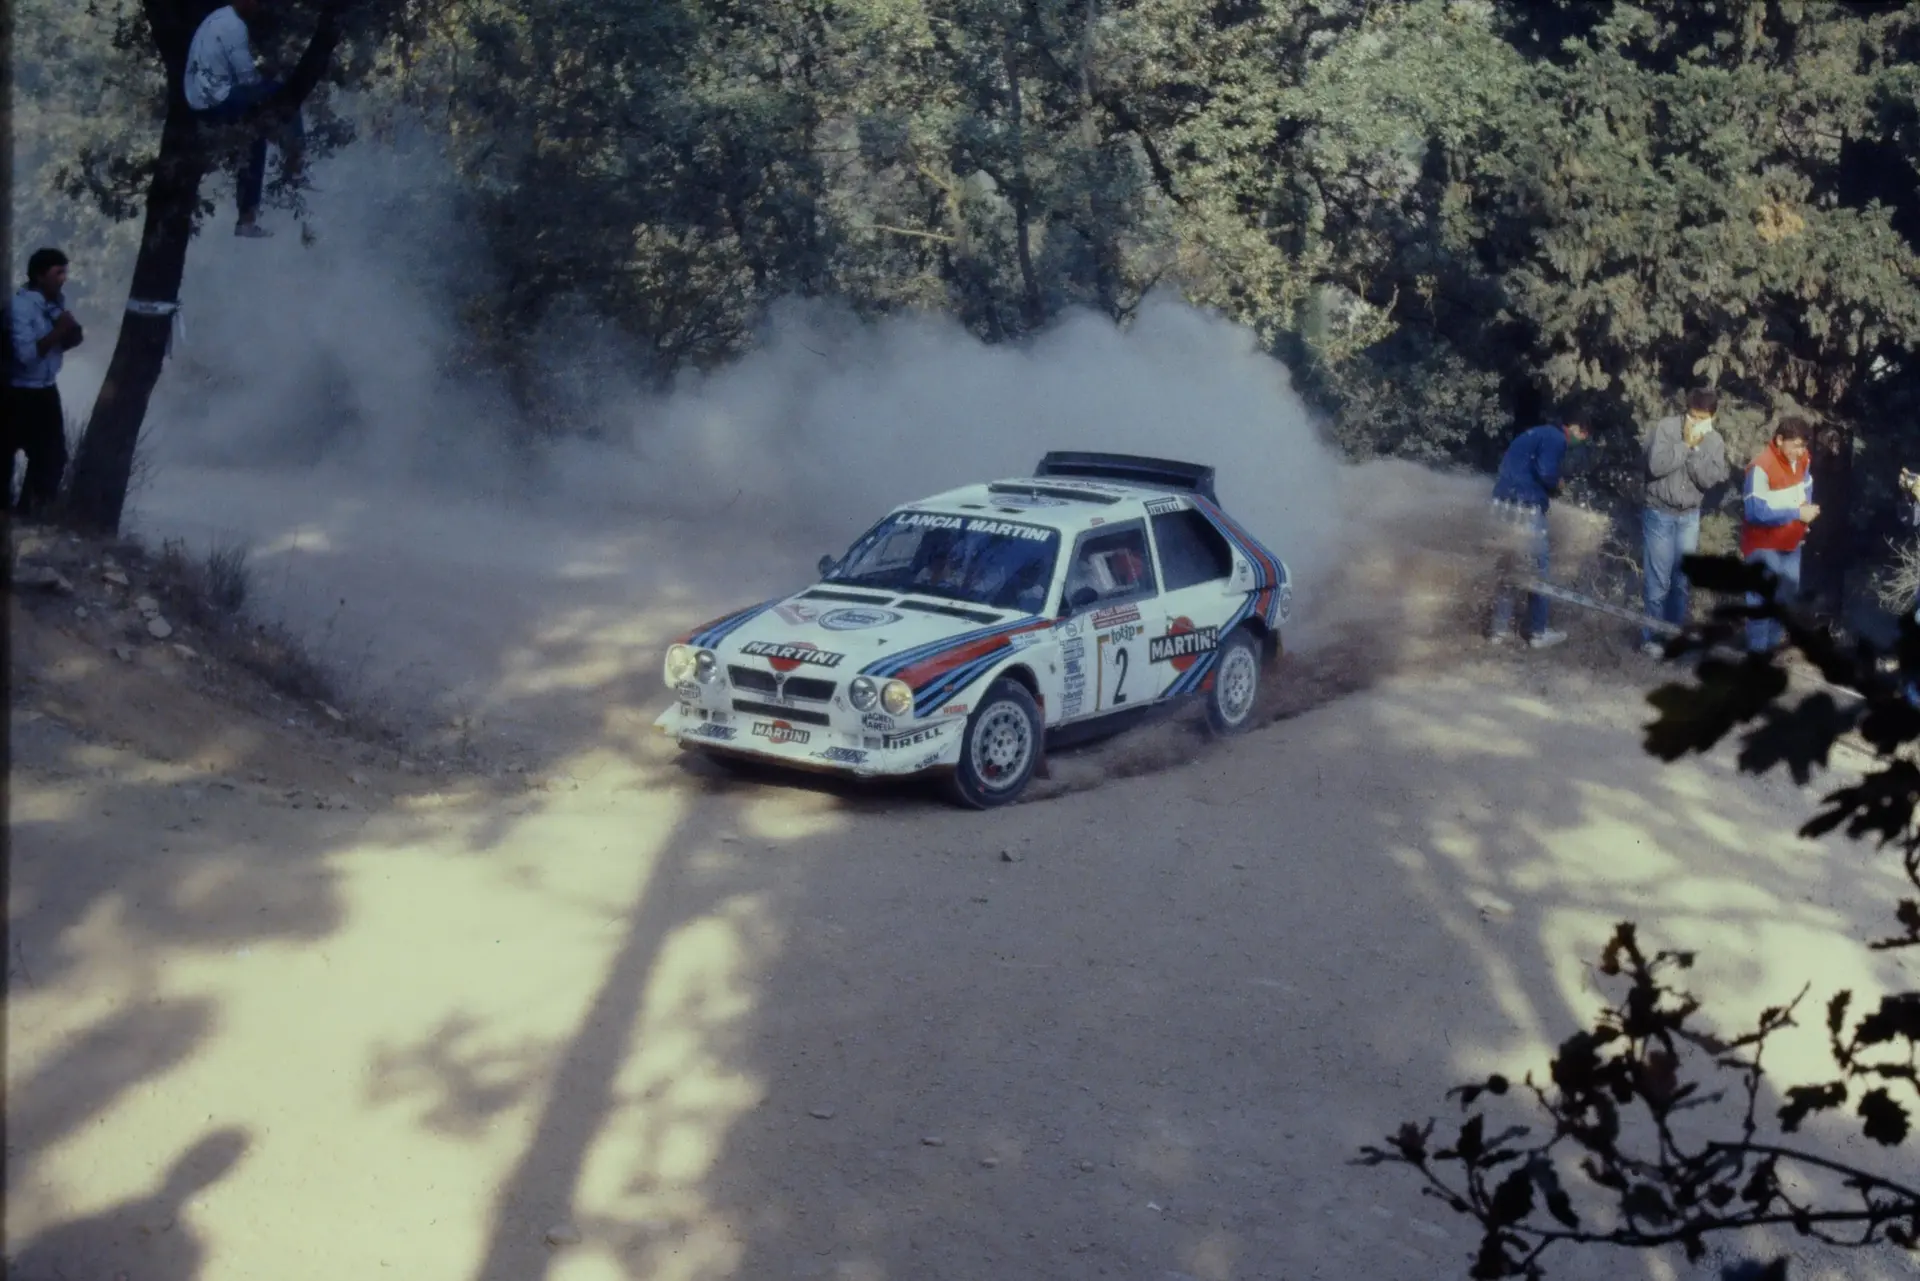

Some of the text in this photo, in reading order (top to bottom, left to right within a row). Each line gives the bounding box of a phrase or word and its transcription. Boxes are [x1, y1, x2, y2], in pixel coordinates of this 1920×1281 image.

[895, 513, 1051, 542] LANCIA MARTINI
[744, 641, 840, 665] MARTINI
[1151, 627, 1217, 661] MARTINI
[1113, 647, 1129, 704] 2
[754, 723, 809, 743] MARTINI
